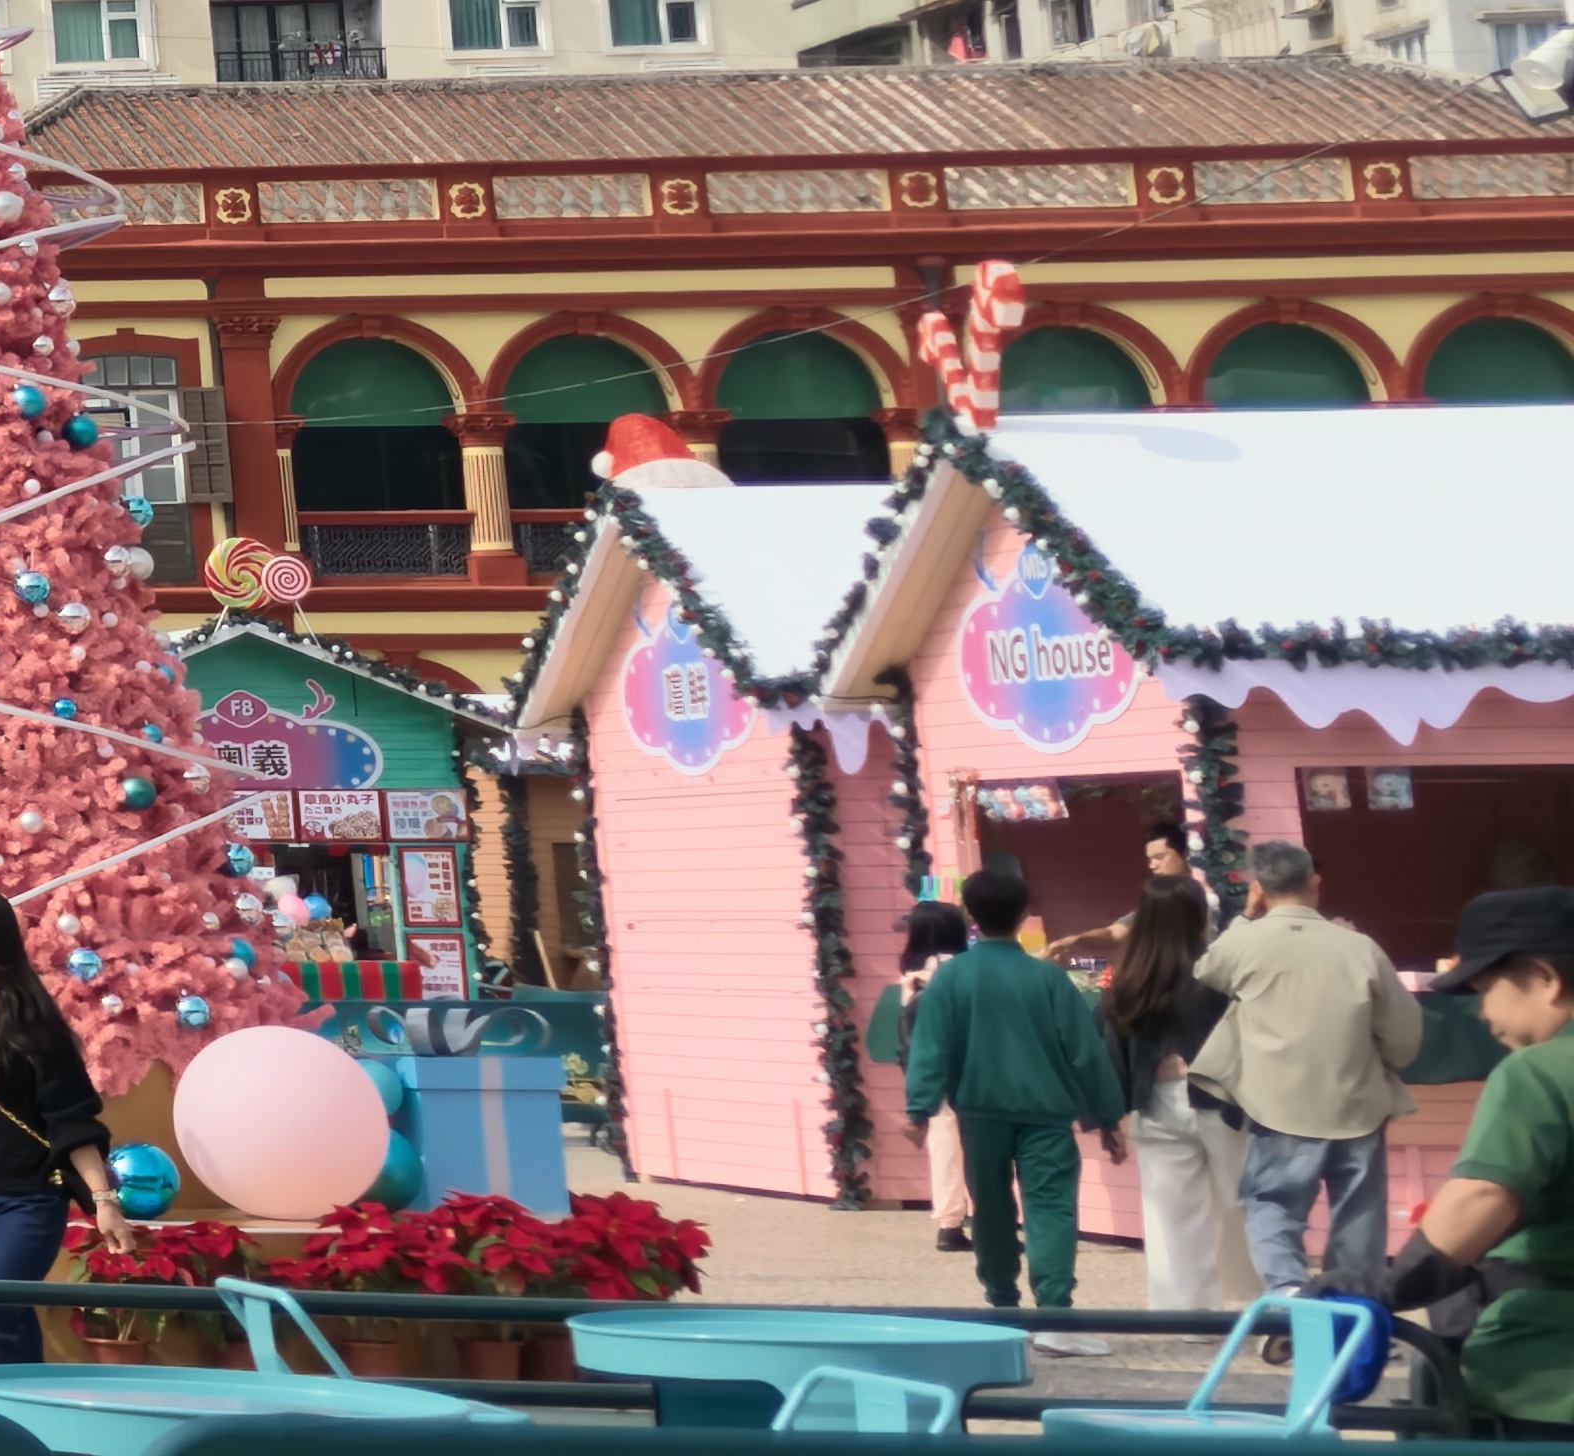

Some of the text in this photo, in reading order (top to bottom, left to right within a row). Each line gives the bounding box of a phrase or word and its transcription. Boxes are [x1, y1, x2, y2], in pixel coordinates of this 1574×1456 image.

[989, 630, 1112, 681] NG house
[230, 699, 254, 717] F8
